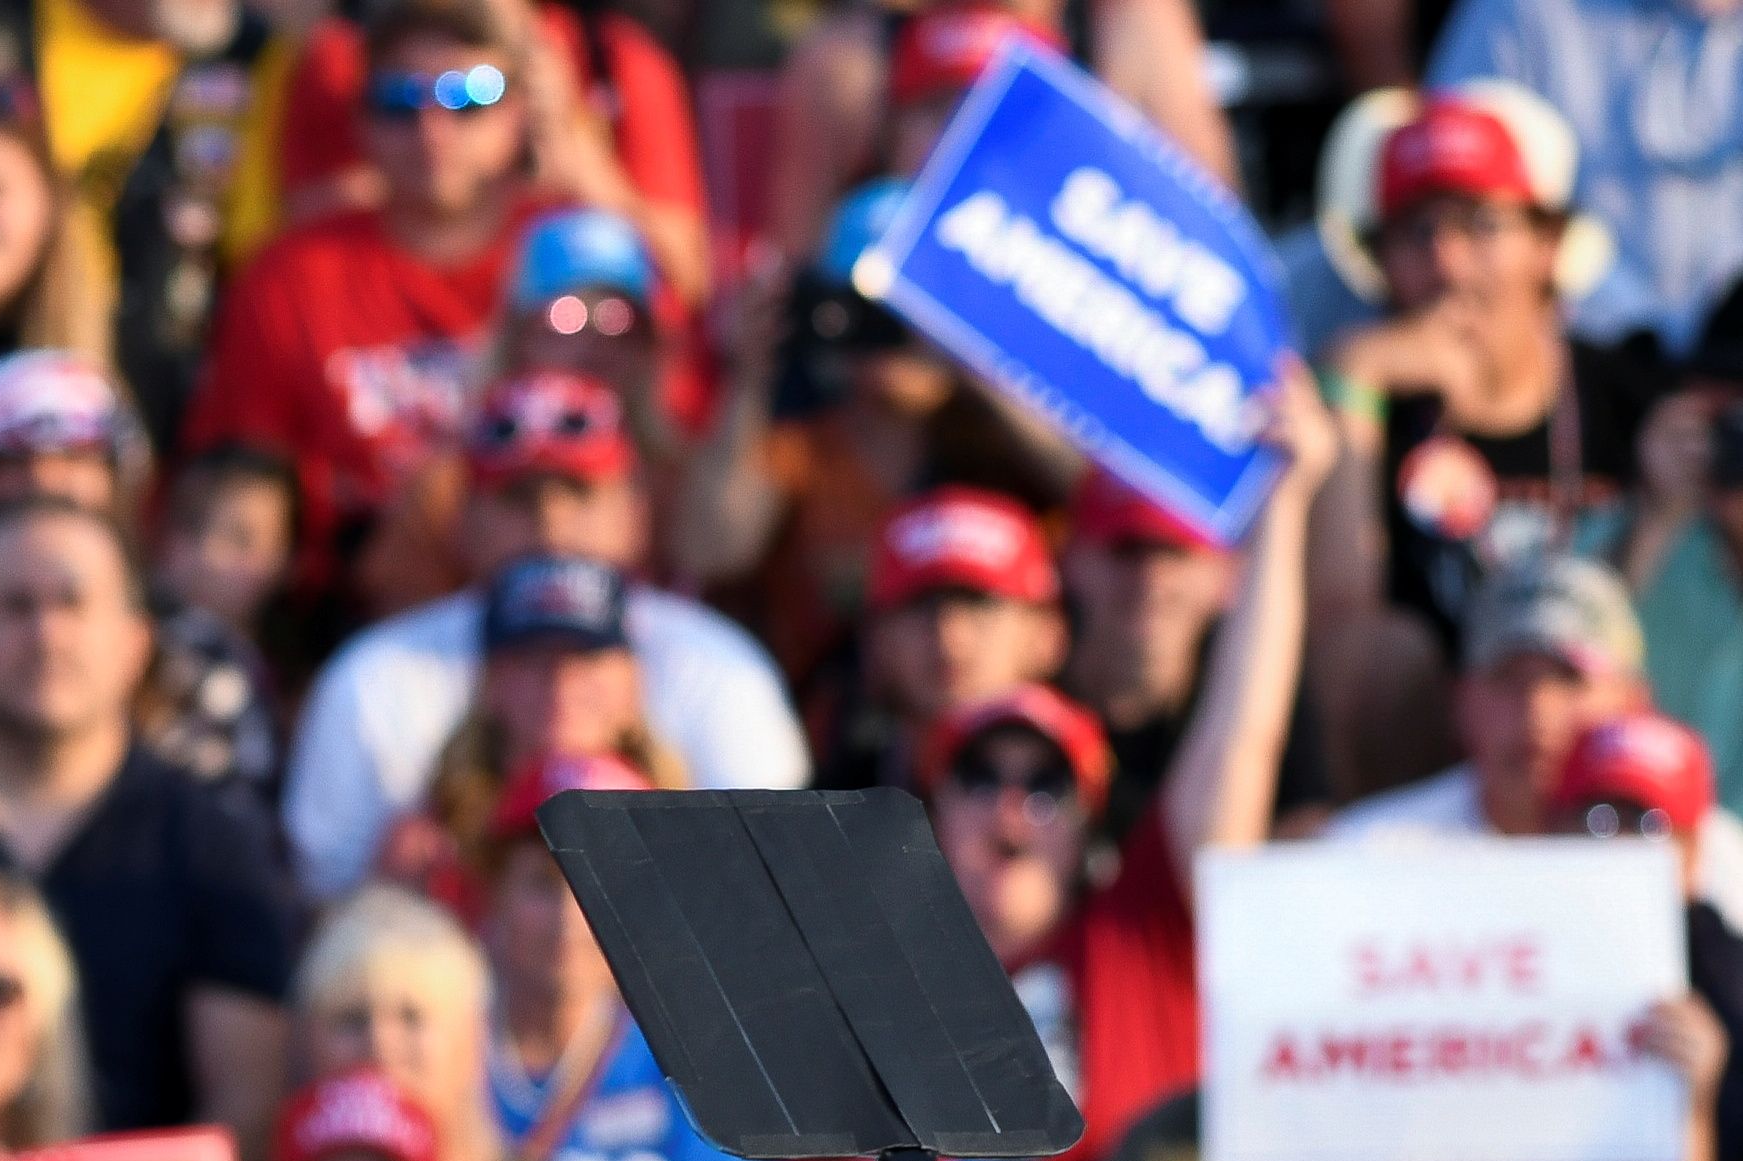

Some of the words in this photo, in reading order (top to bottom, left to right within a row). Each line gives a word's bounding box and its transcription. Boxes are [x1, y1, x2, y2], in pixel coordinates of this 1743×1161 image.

[936, 192, 1264, 457] AMERICA
[1052, 167, 1246, 336] SAVE
[1344, 934, 1544, 998] SAVE
